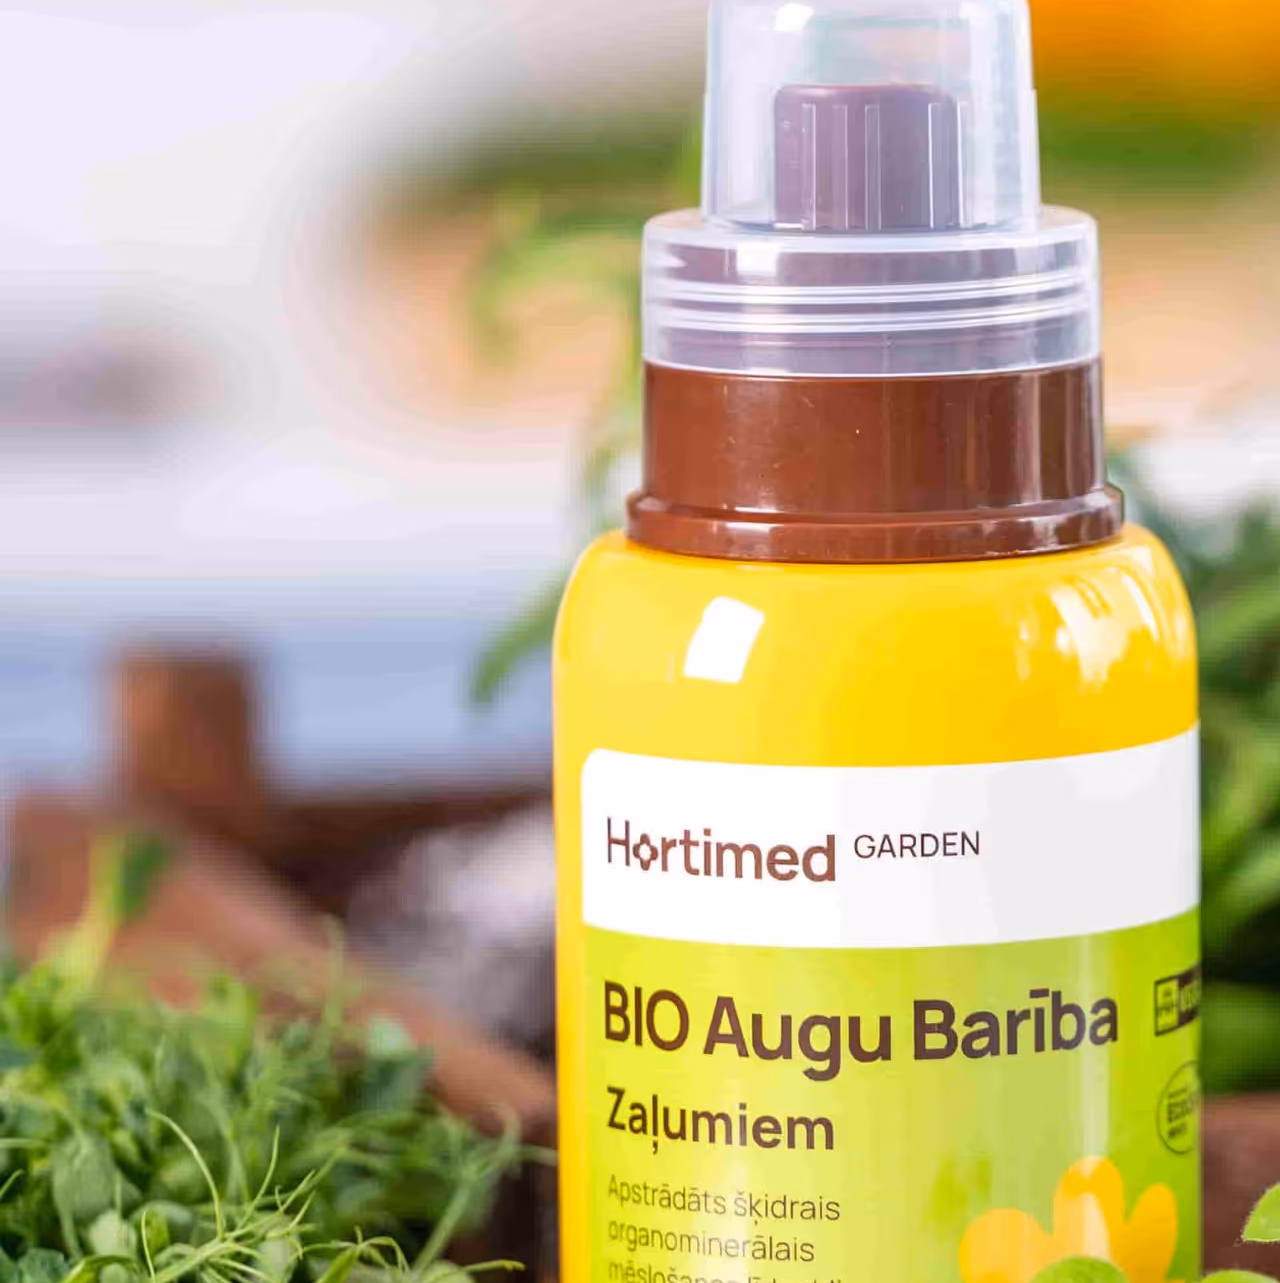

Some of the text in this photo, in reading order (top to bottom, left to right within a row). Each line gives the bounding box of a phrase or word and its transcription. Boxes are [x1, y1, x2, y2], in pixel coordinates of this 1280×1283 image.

[607, 816, 981, 882] Hortimed GARDEN
[603, 980, 690, 1052] BIO
[703, 995, 892, 1081] Augu
[912, 988, 1119, 1061] Barība
[606, 1084, 835, 1155] Zaļumiem
[608, 1174, 841, 1226] Apstrādāts šķidrais
[608, 1219, 816, 1263] organominerālais
